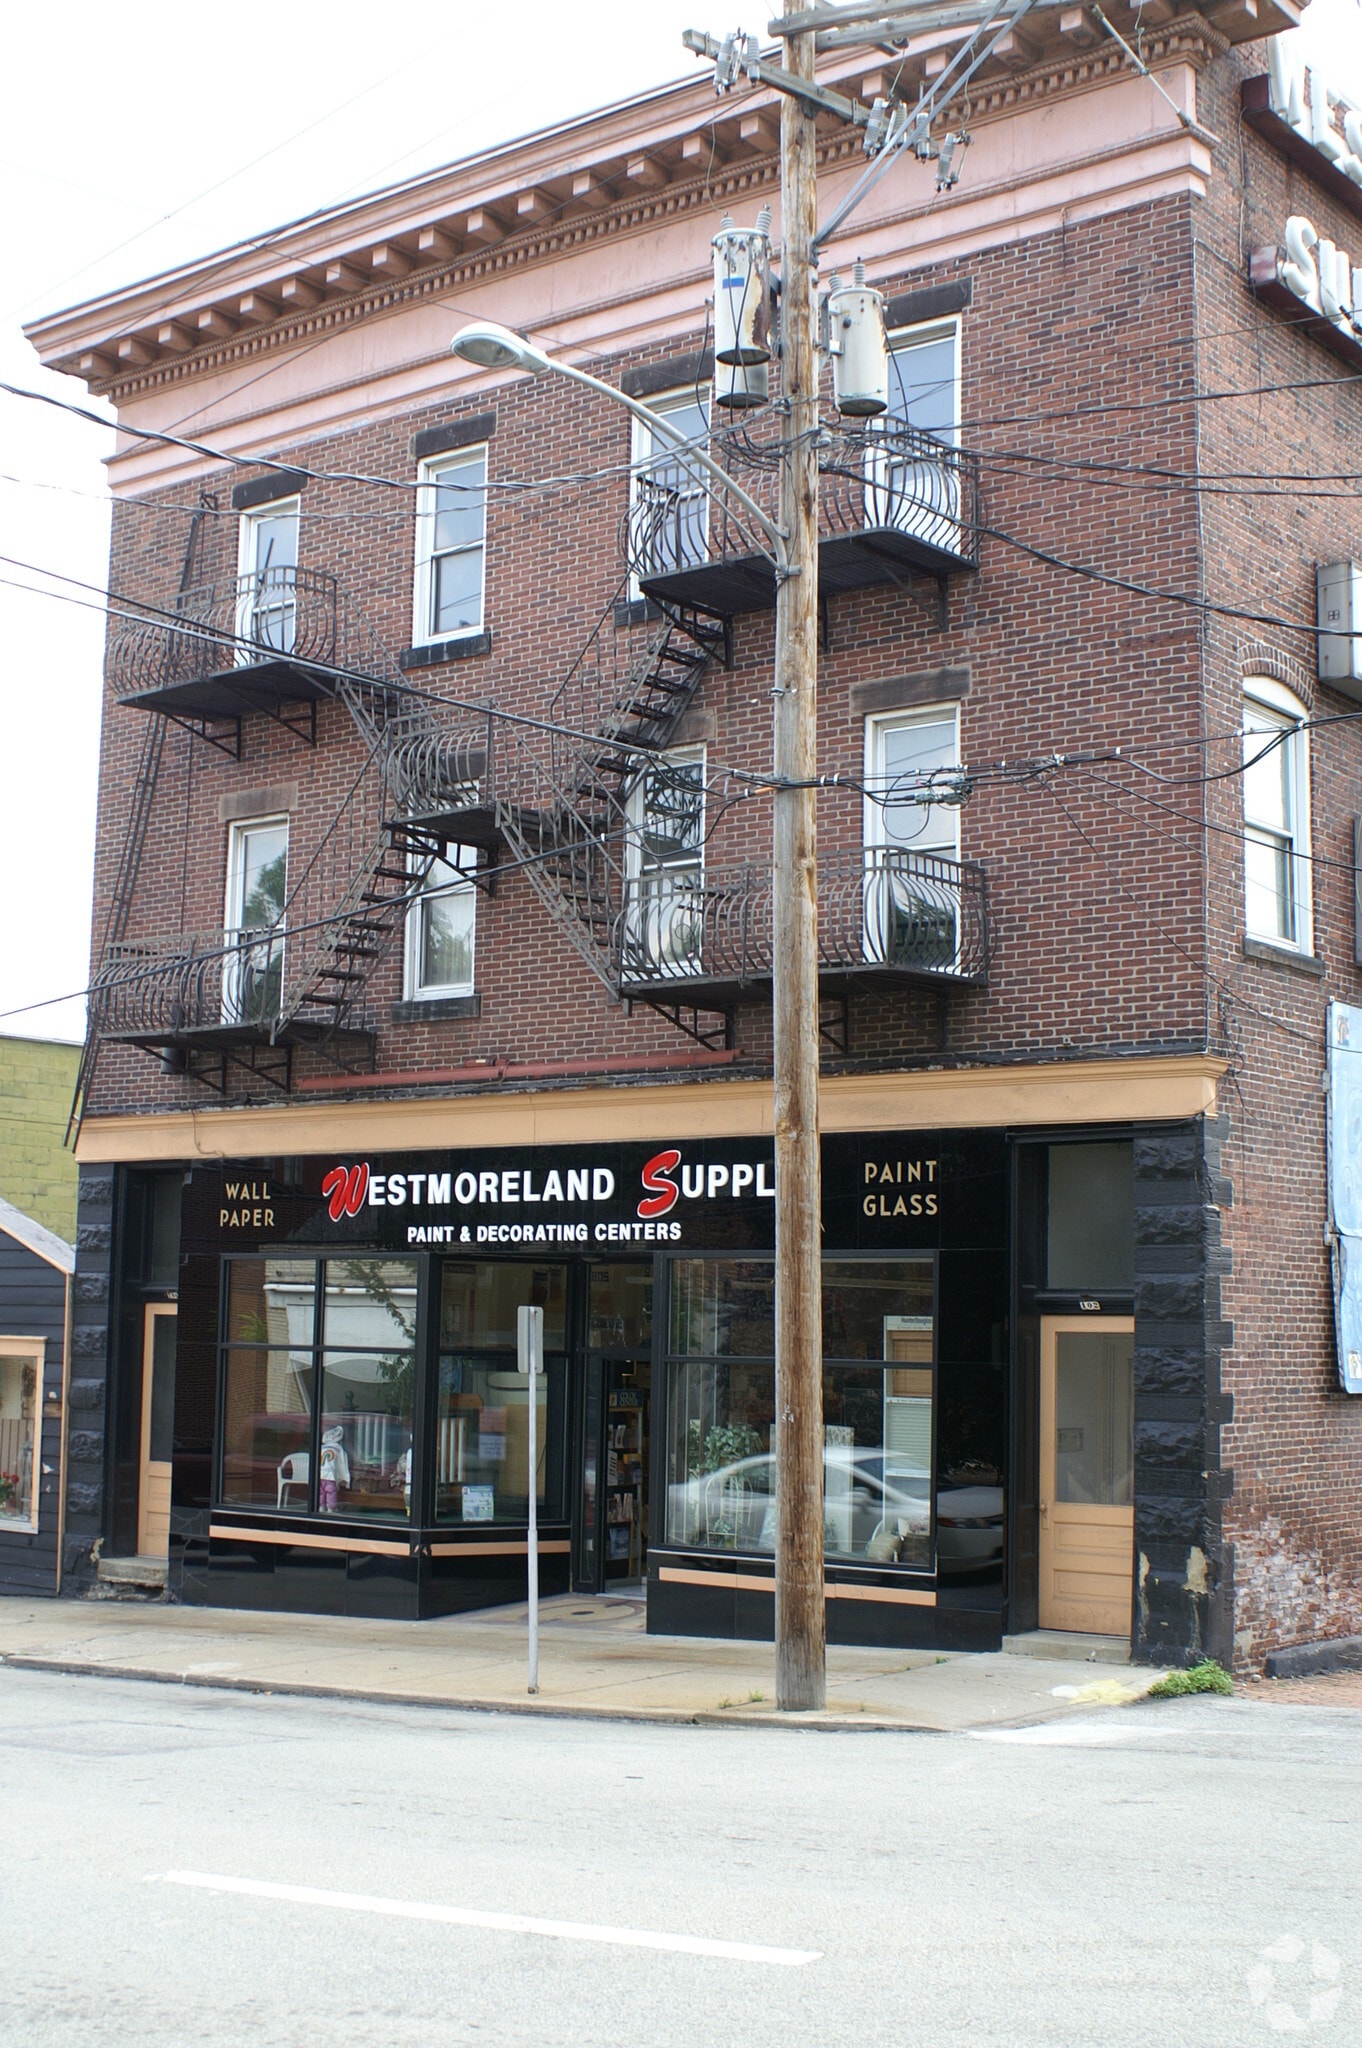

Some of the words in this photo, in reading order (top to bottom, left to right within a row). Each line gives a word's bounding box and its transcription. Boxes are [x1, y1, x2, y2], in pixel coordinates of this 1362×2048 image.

[865, 1160, 937, 1184] PAINT
[225, 1182, 271, 1200] WALL
[322, 1162, 615, 1222] WESTMORELAND
[637, 1150, 776, 1219] SUPPL
[863, 1194, 938, 1216] GLASS
[220, 1209, 275, 1227] PAPER
[407, 1226, 454, 1243] PAINT
[459, 1225, 471, 1243] &
[476, 1224, 588, 1242] DECORATING
[594, 1222, 681, 1241] CENTERS
[1081, 1301, 1099, 1309] 102
